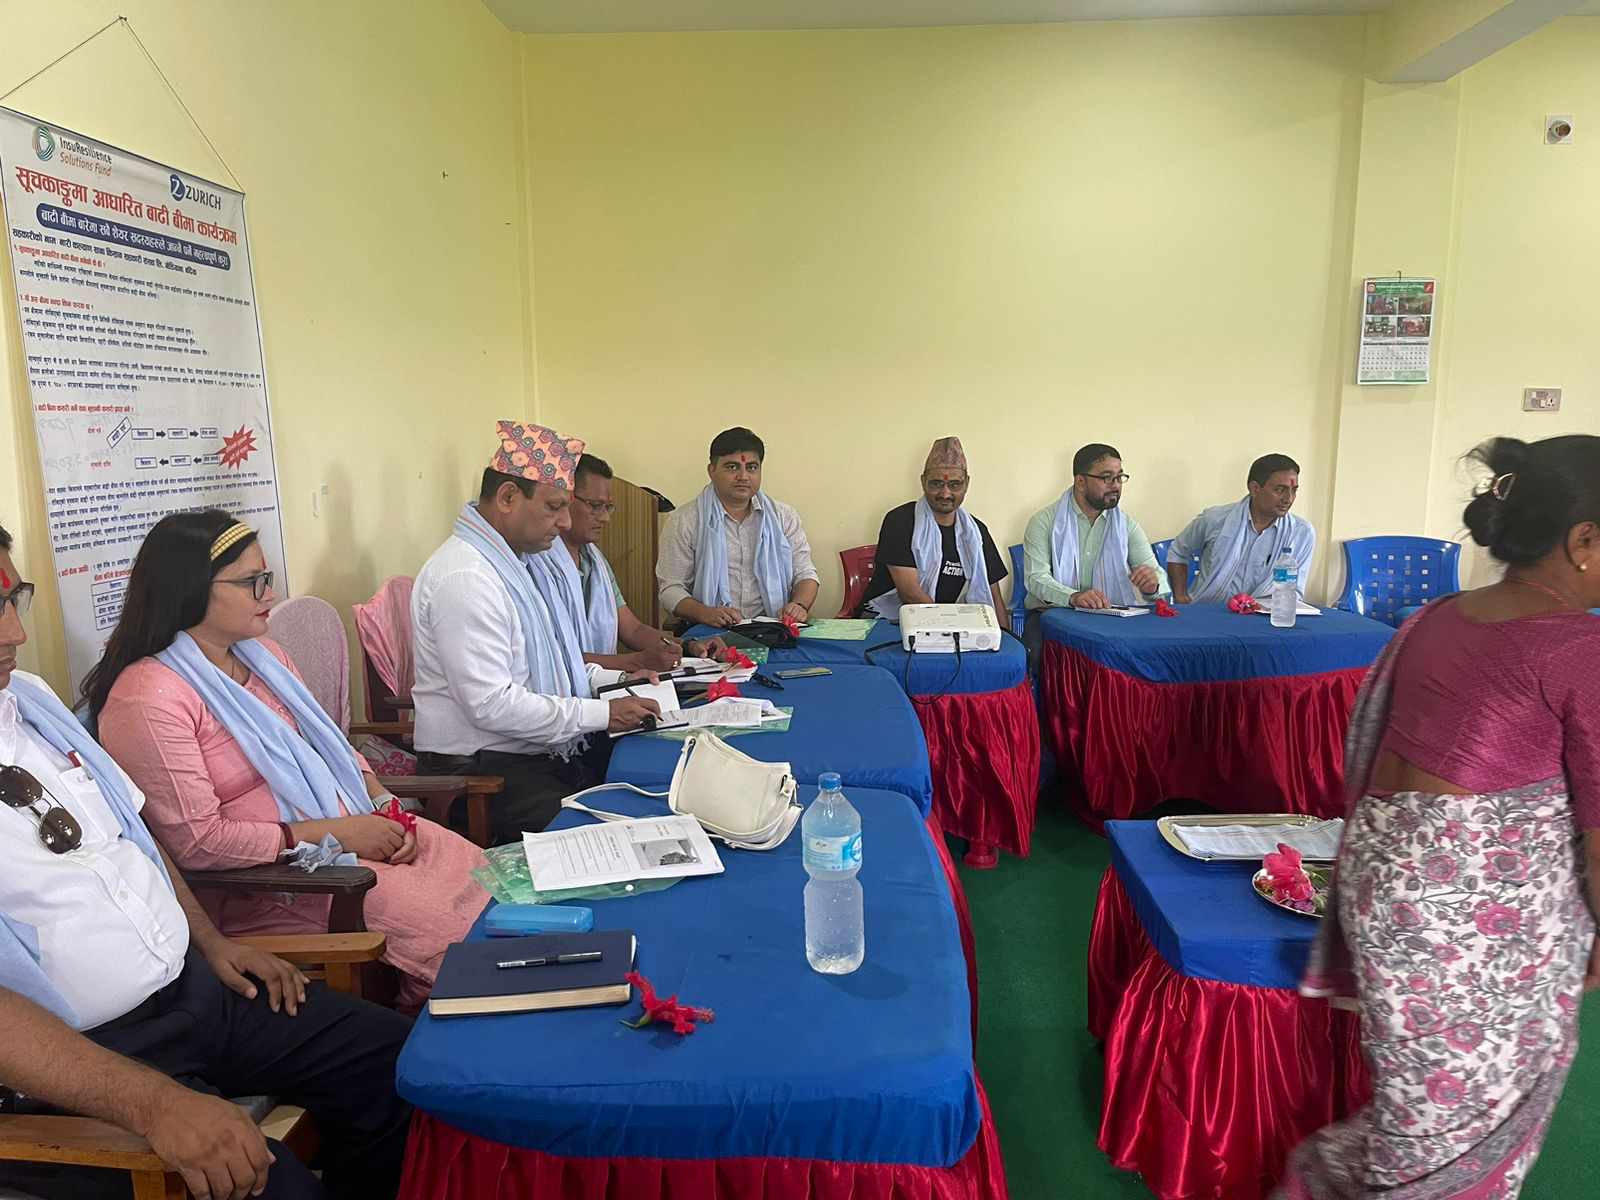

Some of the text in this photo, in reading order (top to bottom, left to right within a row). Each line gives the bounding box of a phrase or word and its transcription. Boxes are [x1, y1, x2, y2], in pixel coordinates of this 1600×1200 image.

[59, 137, 112, 164] InsuResilience
[60, 151, 112, 176] Solutions Fund
[185, 185, 222, 210] ZURICH
[93, 189, 143, 218] आधारित
[146, 204, 170, 226] बाढी
[172, 208, 195, 233] बीमा
[196, 221, 238, 245] कार्यक्रम
